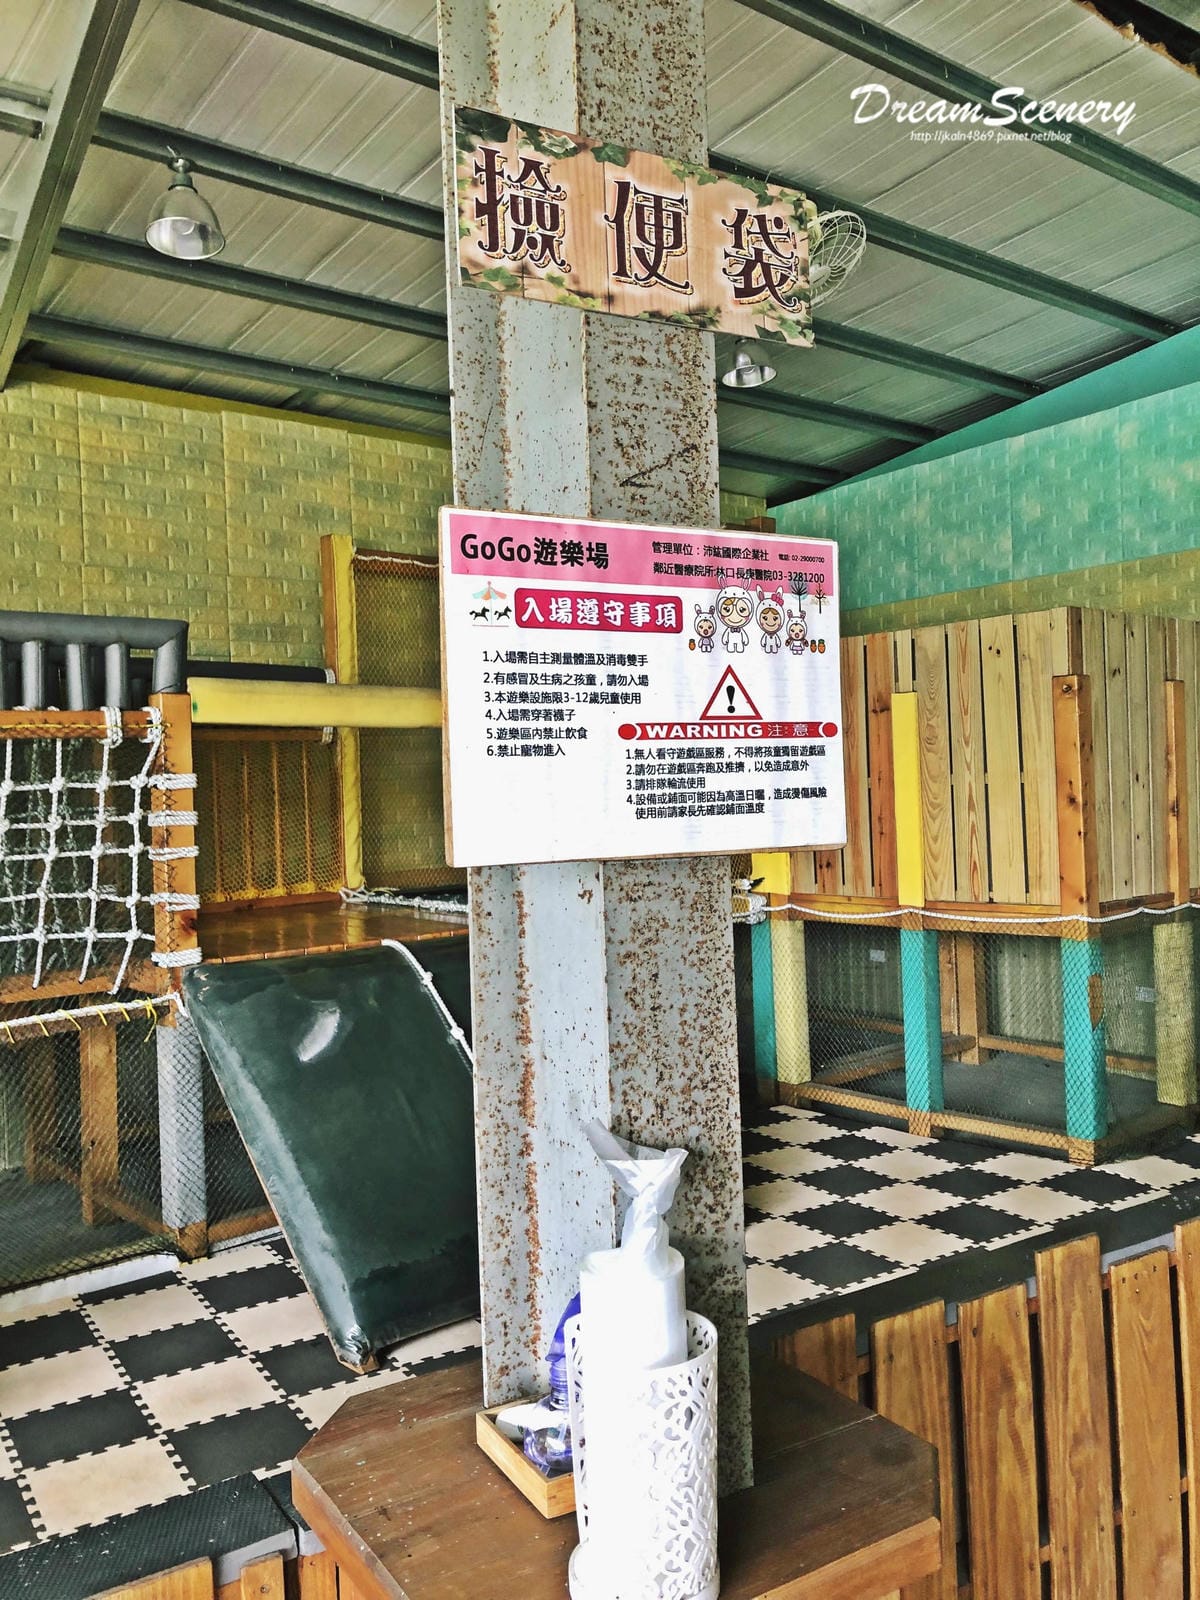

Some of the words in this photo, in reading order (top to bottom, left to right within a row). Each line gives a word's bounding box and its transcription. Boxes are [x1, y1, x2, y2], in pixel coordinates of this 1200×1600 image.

[474, 145, 802, 313] 撿便袋
[460, 533, 609, 570] GoGo遊樂場
[521, 596, 677, 629] 入場遵守事項
[482, 650, 648, 667] 1.入場需自主測量體溫及消毒雙手
[484, 690, 641, 705] 3.本遊樂設施限3-12歲兒童使用
[485, 708, 577, 722] 4.入場需穿著襪子
[486, 726, 588, 741] 5.遊樂區內禁止飲食
[645, 723, 763, 738] WARNING
[487, 743, 566, 758] 6.禁止寵物進入
[626, 776, 706, 790] 3.請排隊輪流使用
